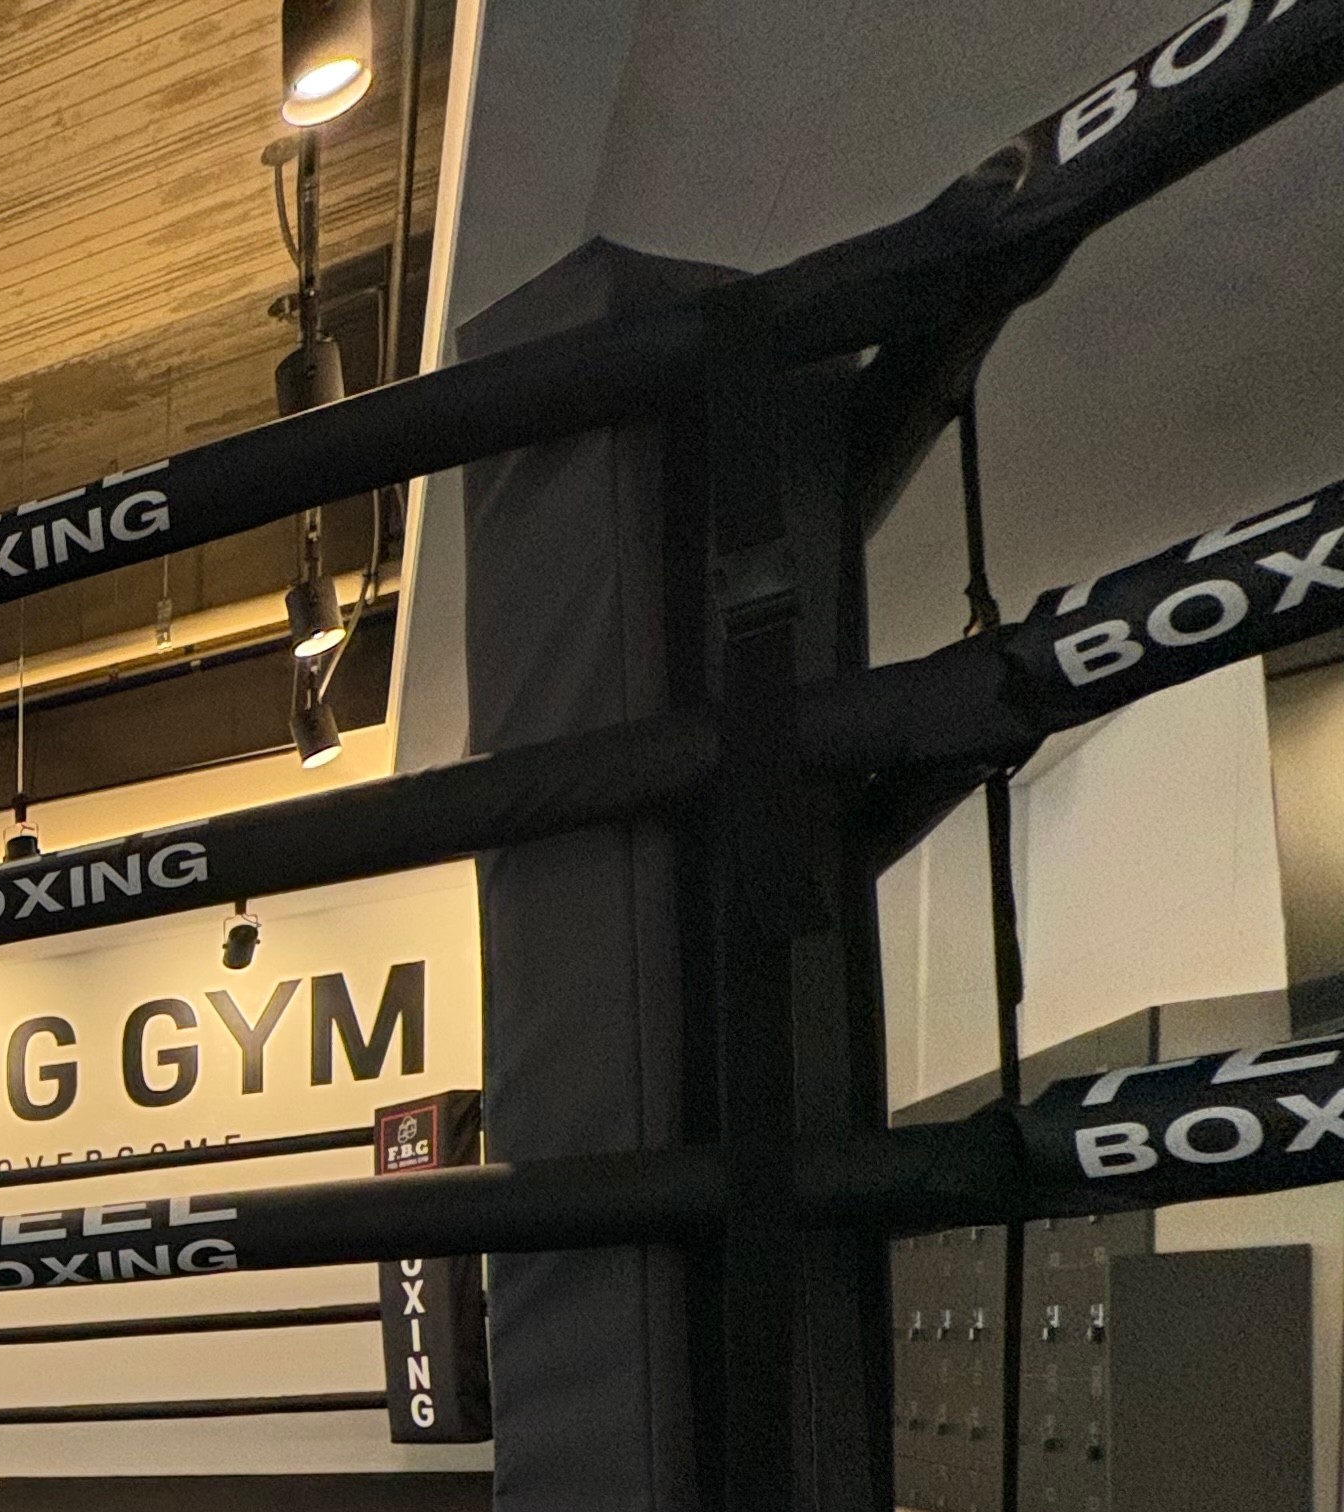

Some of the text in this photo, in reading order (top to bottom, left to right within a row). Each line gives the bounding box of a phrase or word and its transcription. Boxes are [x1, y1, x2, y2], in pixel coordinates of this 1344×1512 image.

[1057, 0, 1298, 166] BO
[121, 961, 428, 1108] GYM
[387, 1140, 429, 1161] F.B.G
[400, 1259, 435, 1428] XING
